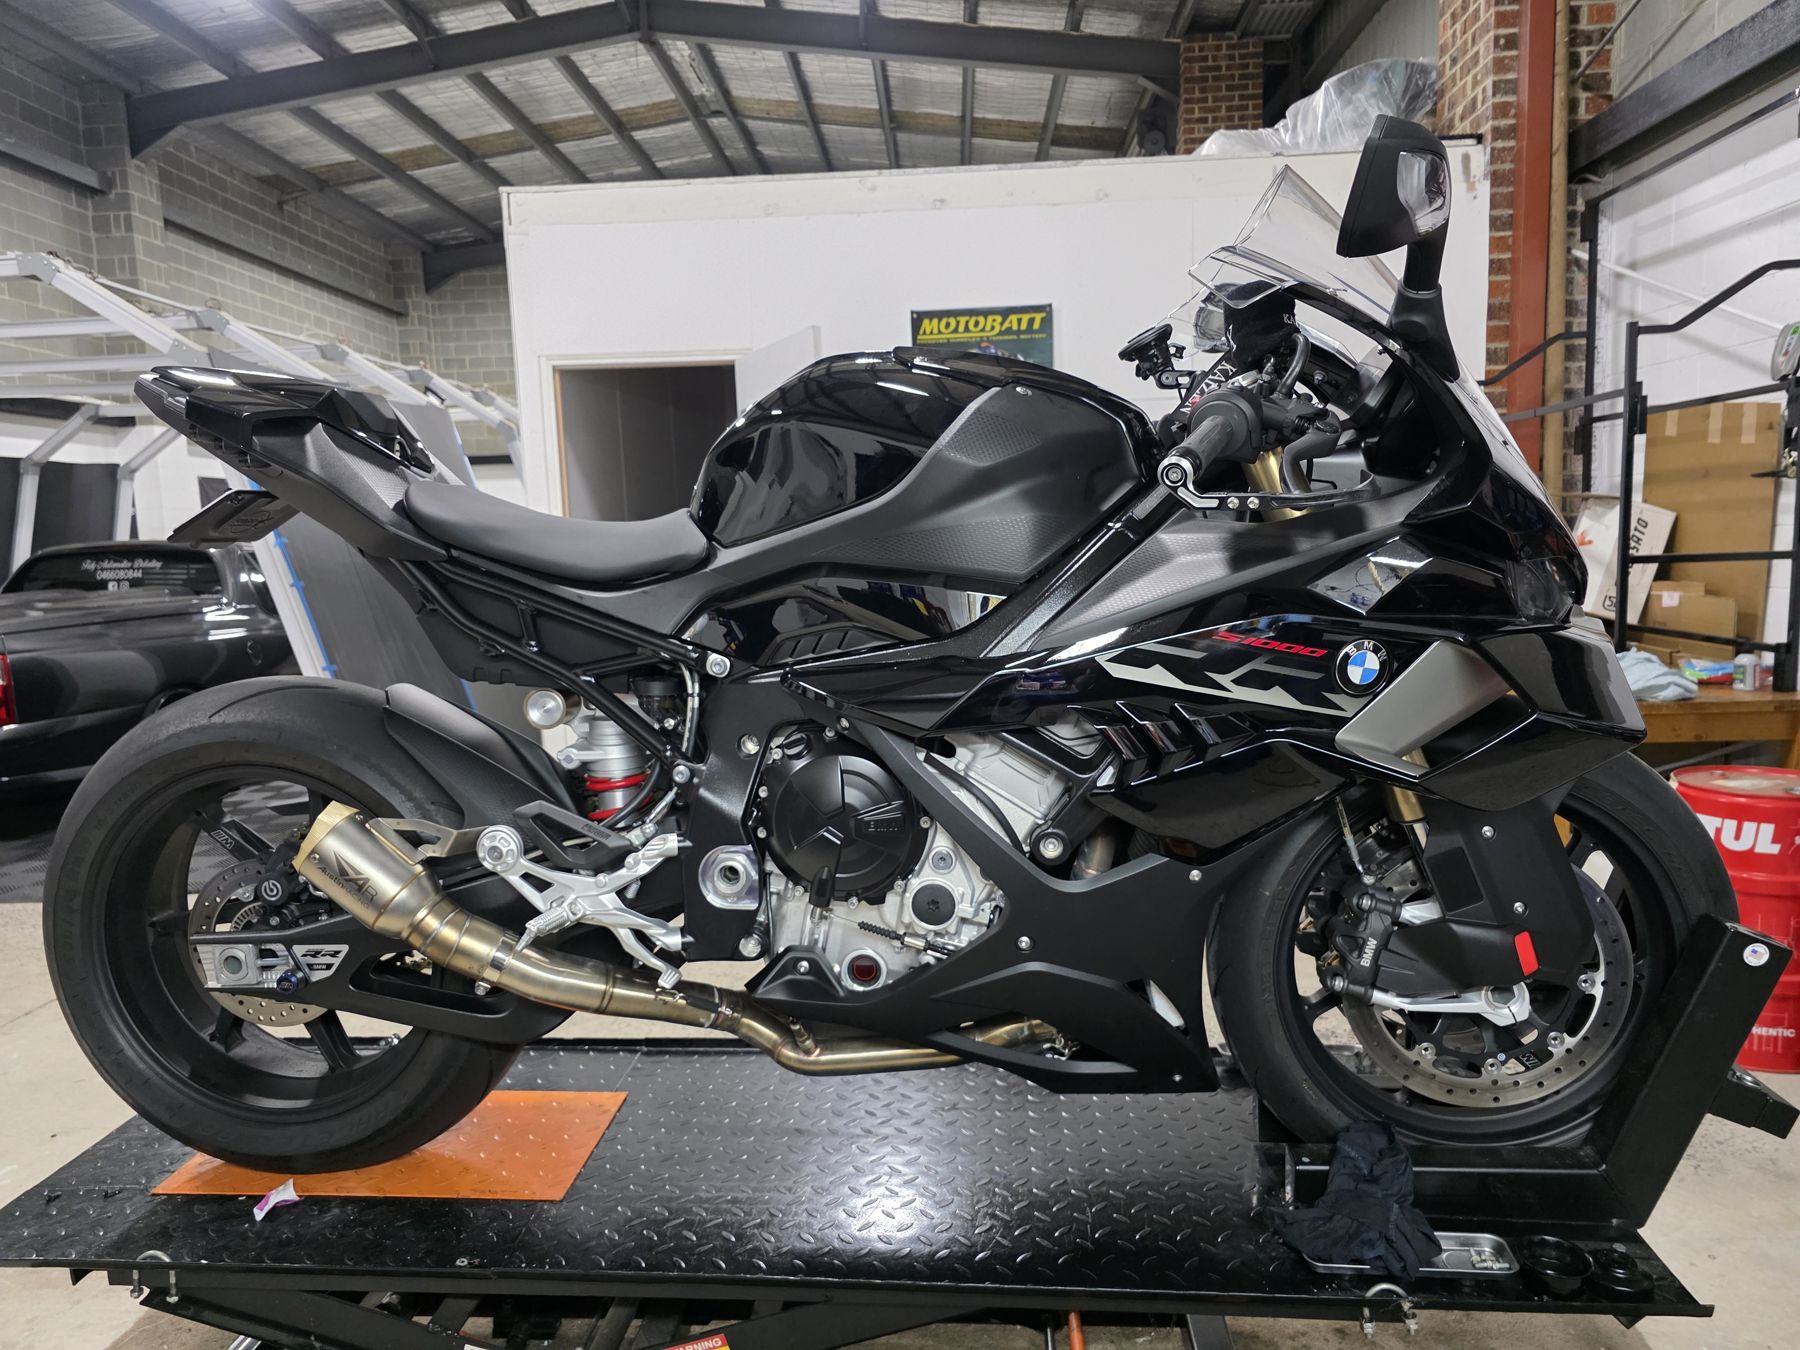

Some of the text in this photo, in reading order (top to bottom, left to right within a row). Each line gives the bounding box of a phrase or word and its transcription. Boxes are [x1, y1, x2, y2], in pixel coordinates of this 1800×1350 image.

[918, 312, 1047, 336] MOTOBATT
[1212, 631, 1328, 657] S1000
[1346, 640, 1388, 662] BMW
[1696, 813, 1782, 855] TUL
[1360, 936, 1378, 967] BMW
